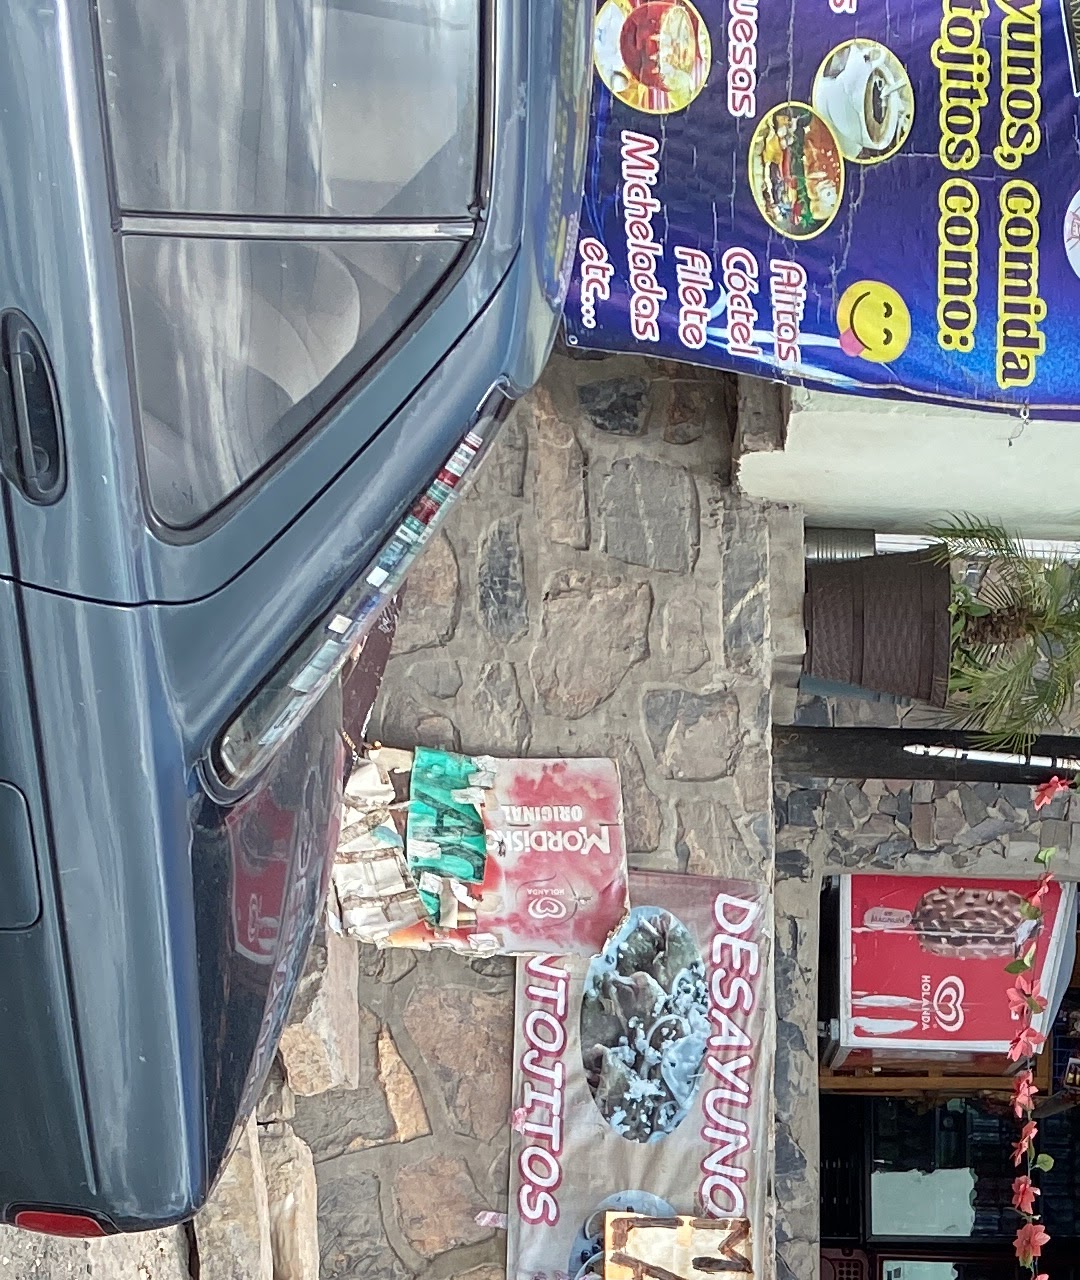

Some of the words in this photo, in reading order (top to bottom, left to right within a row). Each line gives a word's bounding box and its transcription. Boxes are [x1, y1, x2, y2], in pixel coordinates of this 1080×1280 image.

[578, 237, 612, 329] etc...
[620, 130, 659, 343] Micheladas
[937, 179, 979, 352] como:
[997, 179, 1047, 388] comida
[674, 246, 709, 350] Filete
[722, 246, 761, 359] Cóctel
[769, 259, 806, 362] Alitas
[921, 975, 931, 1031] HOLANDA
